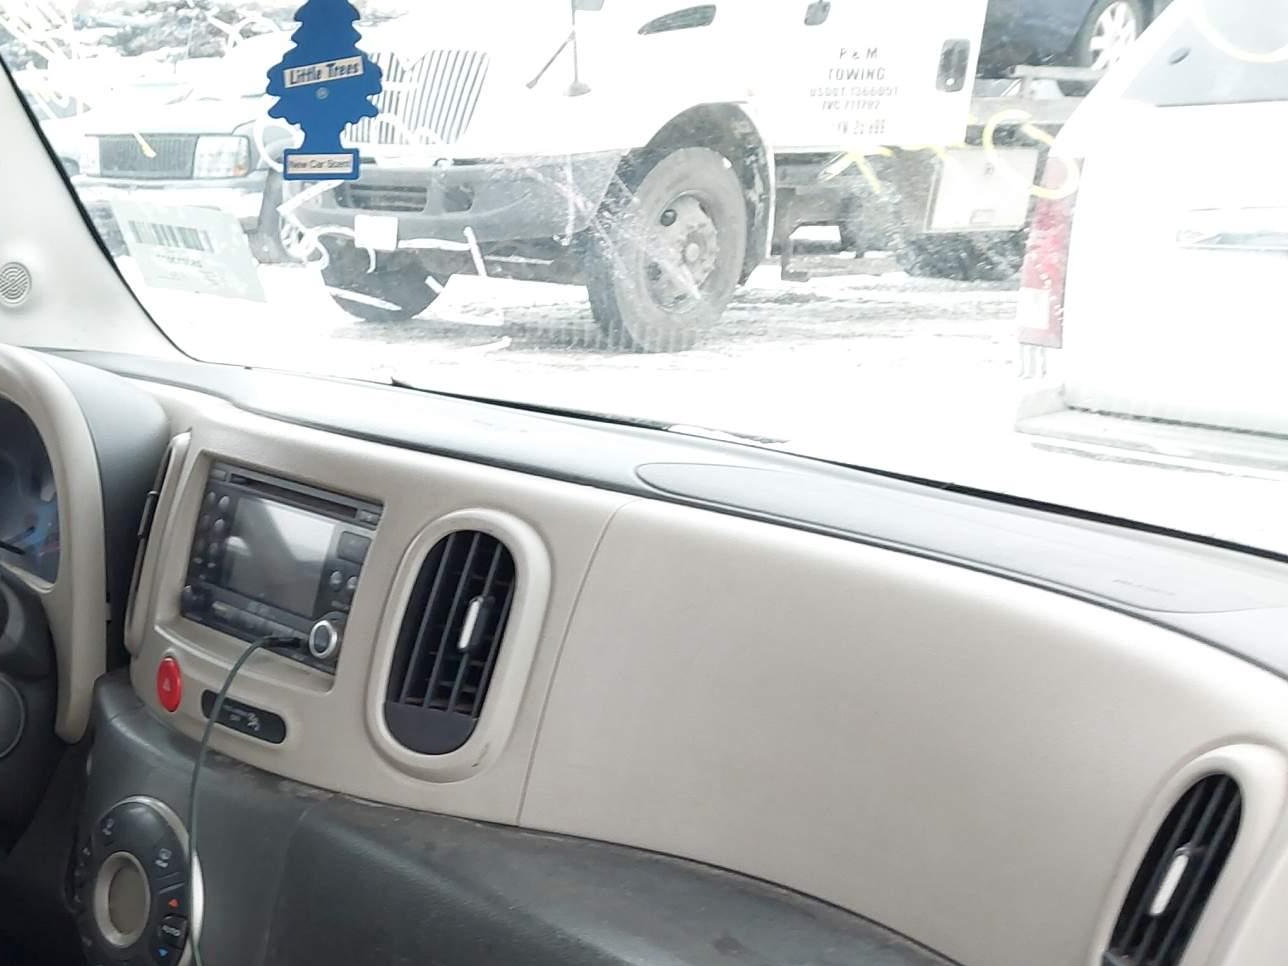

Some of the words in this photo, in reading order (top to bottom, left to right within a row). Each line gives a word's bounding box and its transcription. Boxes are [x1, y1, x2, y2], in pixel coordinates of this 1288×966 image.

[865, 47, 879, 60] M
[290, 65, 322, 86] Little
[326, 61, 359, 78] Trees
[828, 66, 886, 81] TOWING
[289, 159, 307, 169] New
[309, 159, 324, 169] Car
[327, 159, 351, 169] Scent
